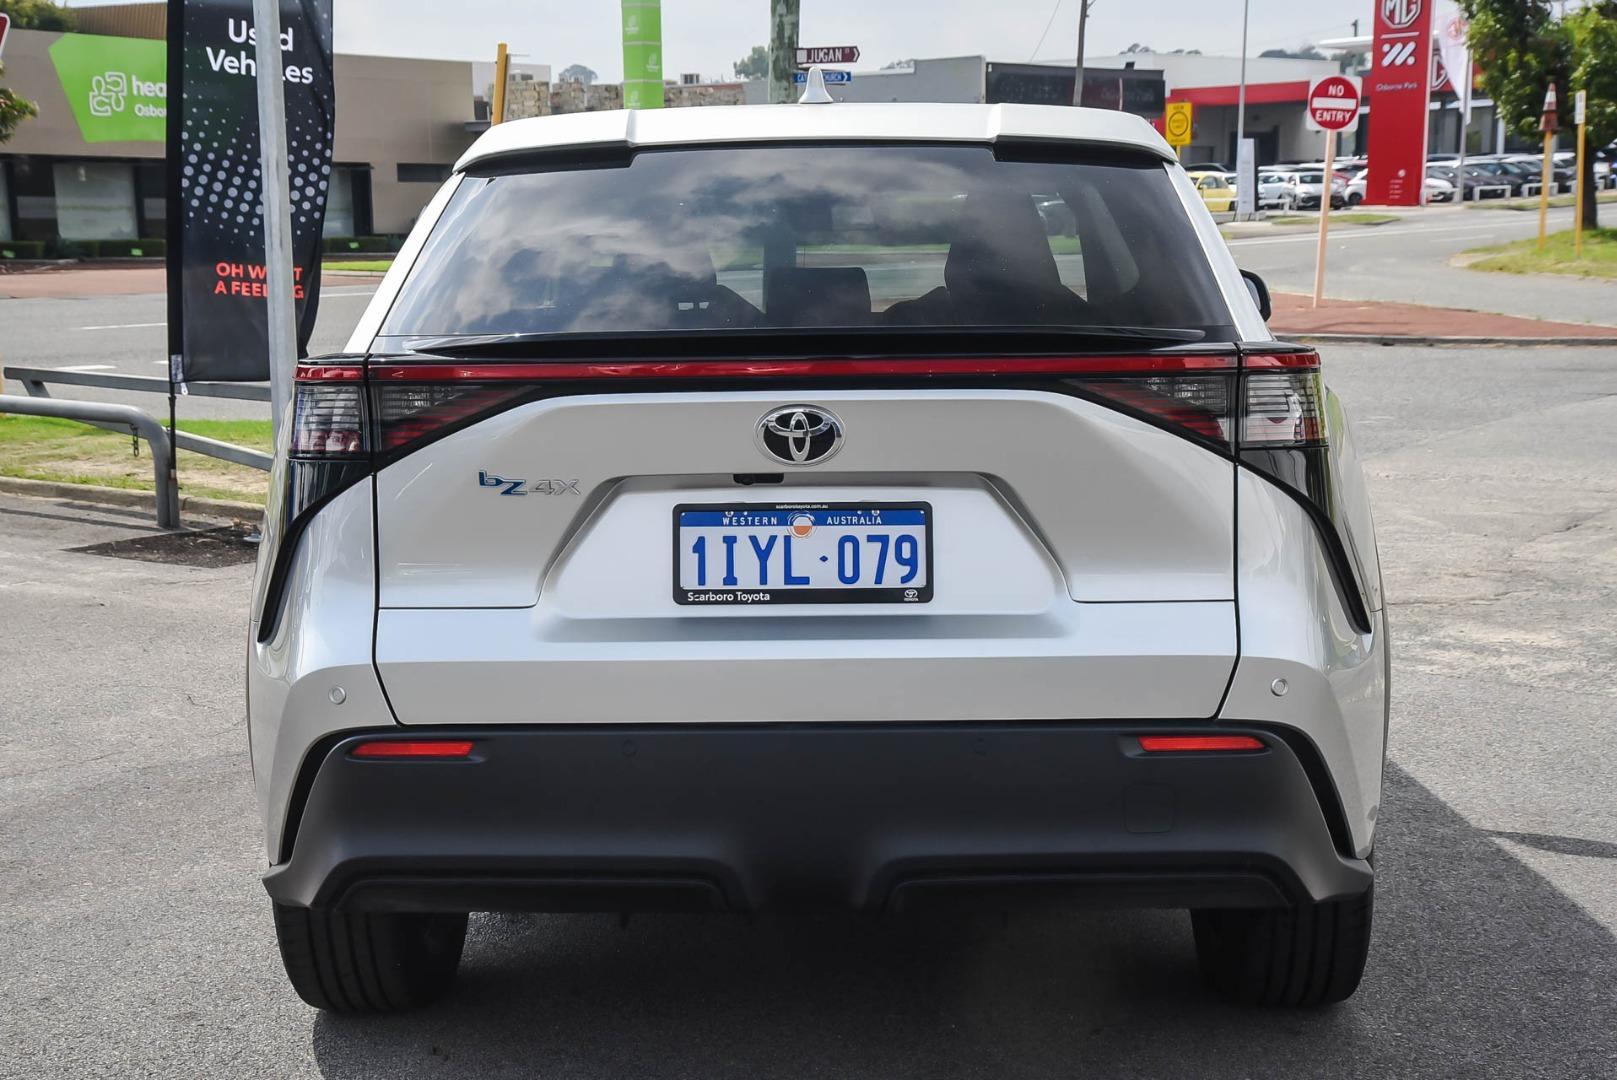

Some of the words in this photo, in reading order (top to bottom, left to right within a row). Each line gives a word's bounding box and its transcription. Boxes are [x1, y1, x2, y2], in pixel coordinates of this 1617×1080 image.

[228, 18, 293, 52] Usd
[808, 48, 842, 62] JUGAN
[205, 46, 313, 84] Vehes
[1328, 85, 1344, 96] NO
[135, 104, 167, 117] Osbo
[1315, 110, 1352, 122] ENTRY
[216, 262, 244, 278] OH
[248, 264, 303, 281] WT
[214, 280, 227, 295] A
[231, 281, 304, 299] FEELG
[722, 516, 778, 526] WESTERN
[826, 515, 882, 525] AUSTRALIA
[687, 592, 734, 602] Scarboro
[735, 592, 770, 604] Toyota
